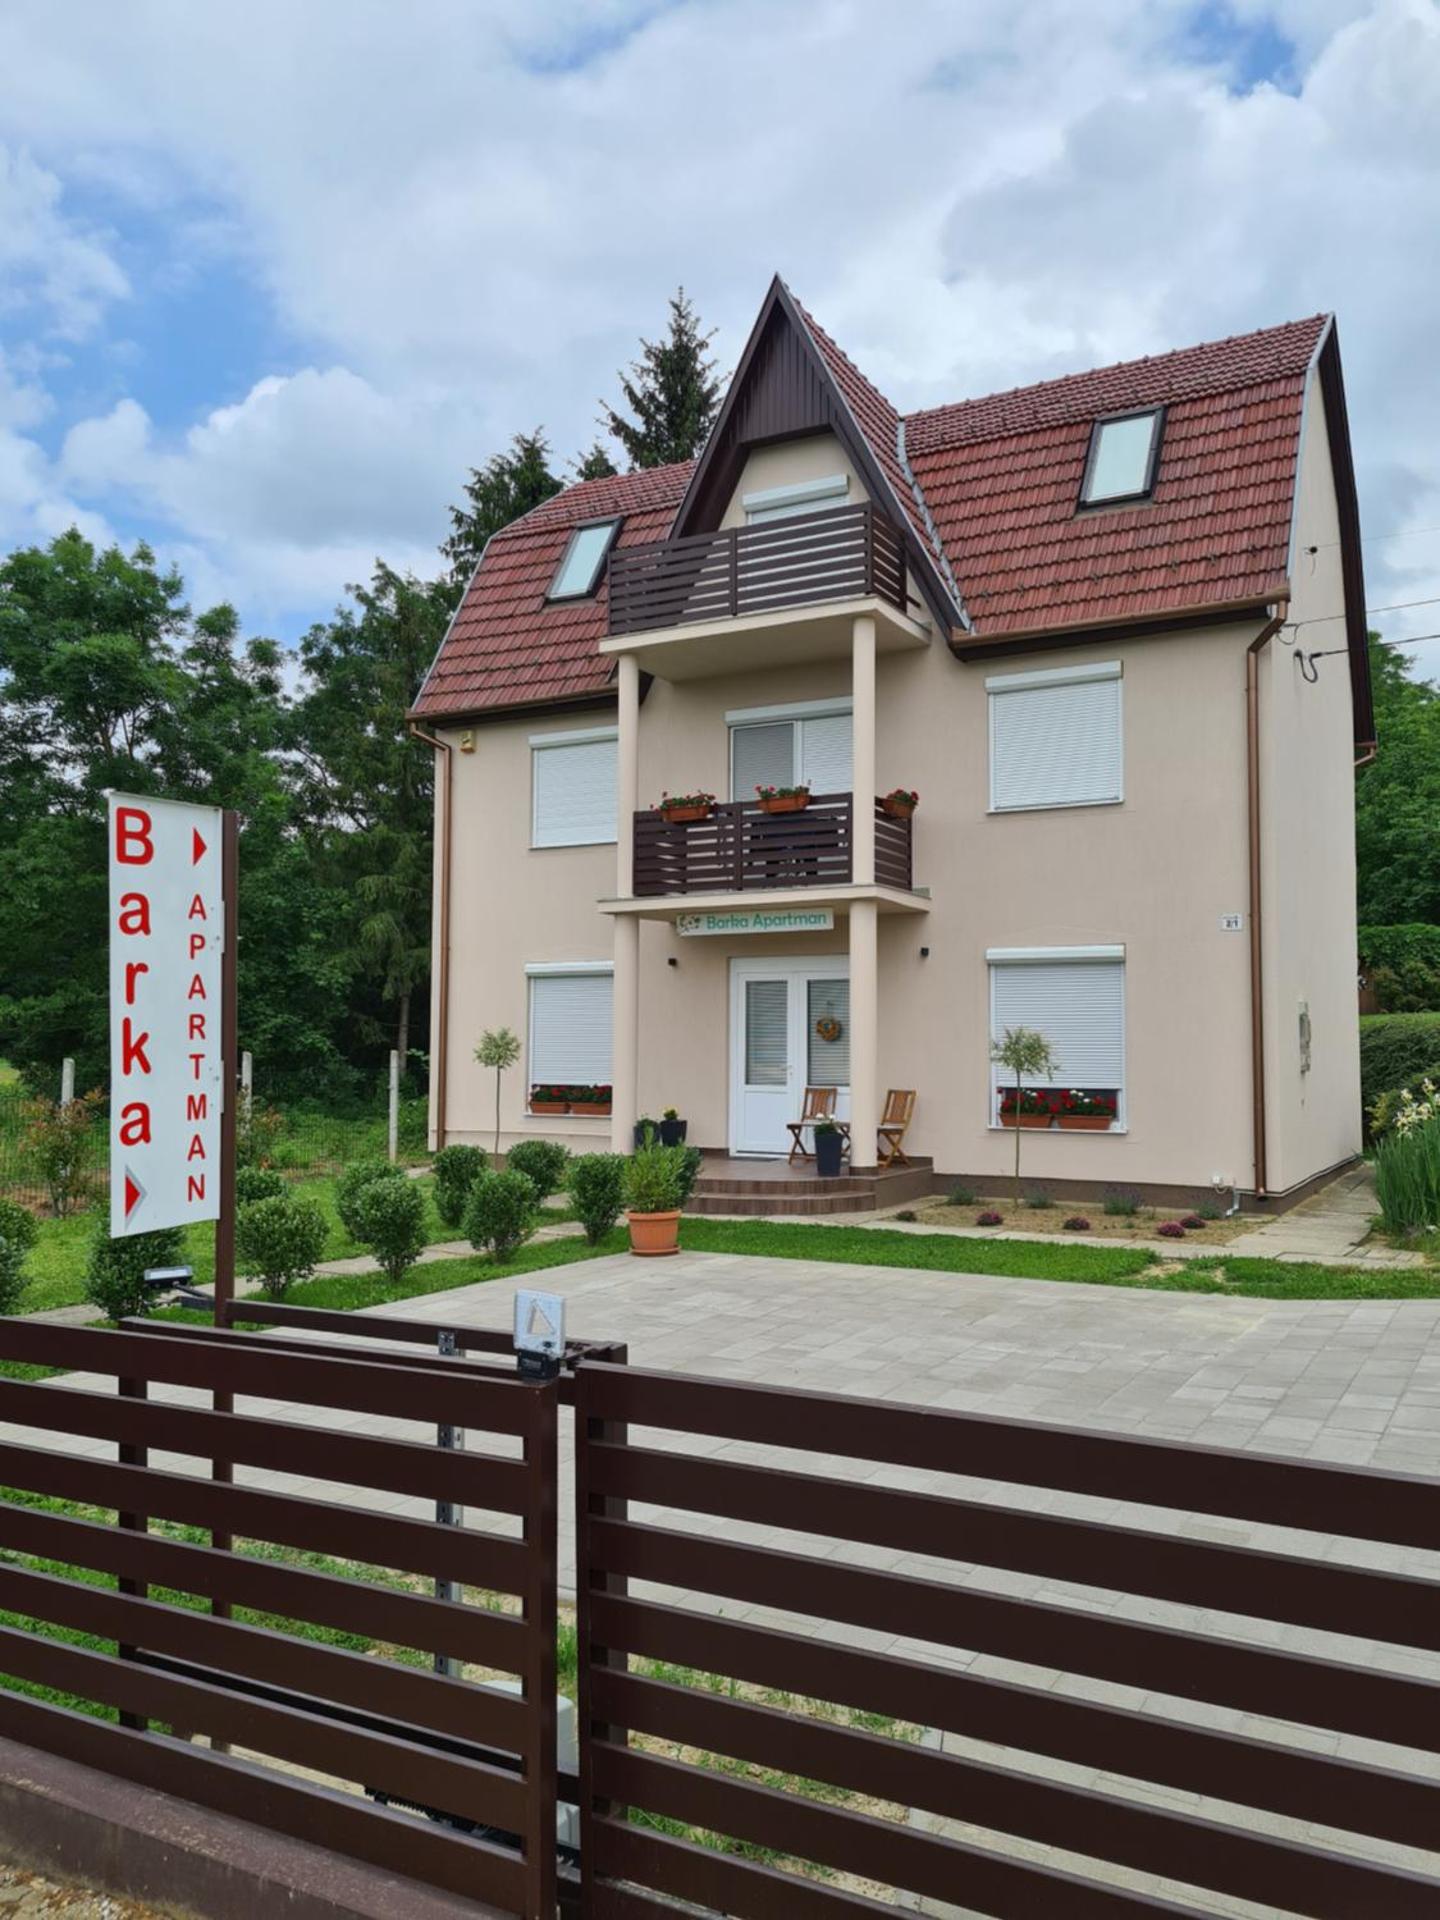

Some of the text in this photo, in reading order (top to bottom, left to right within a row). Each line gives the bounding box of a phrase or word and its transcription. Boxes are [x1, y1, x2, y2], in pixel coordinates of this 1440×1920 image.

[116, 807, 154, 1146] Barka
[187, 894, 206, 1201] APARTMAN
[706, 913, 827, 930] Barka Apartman
